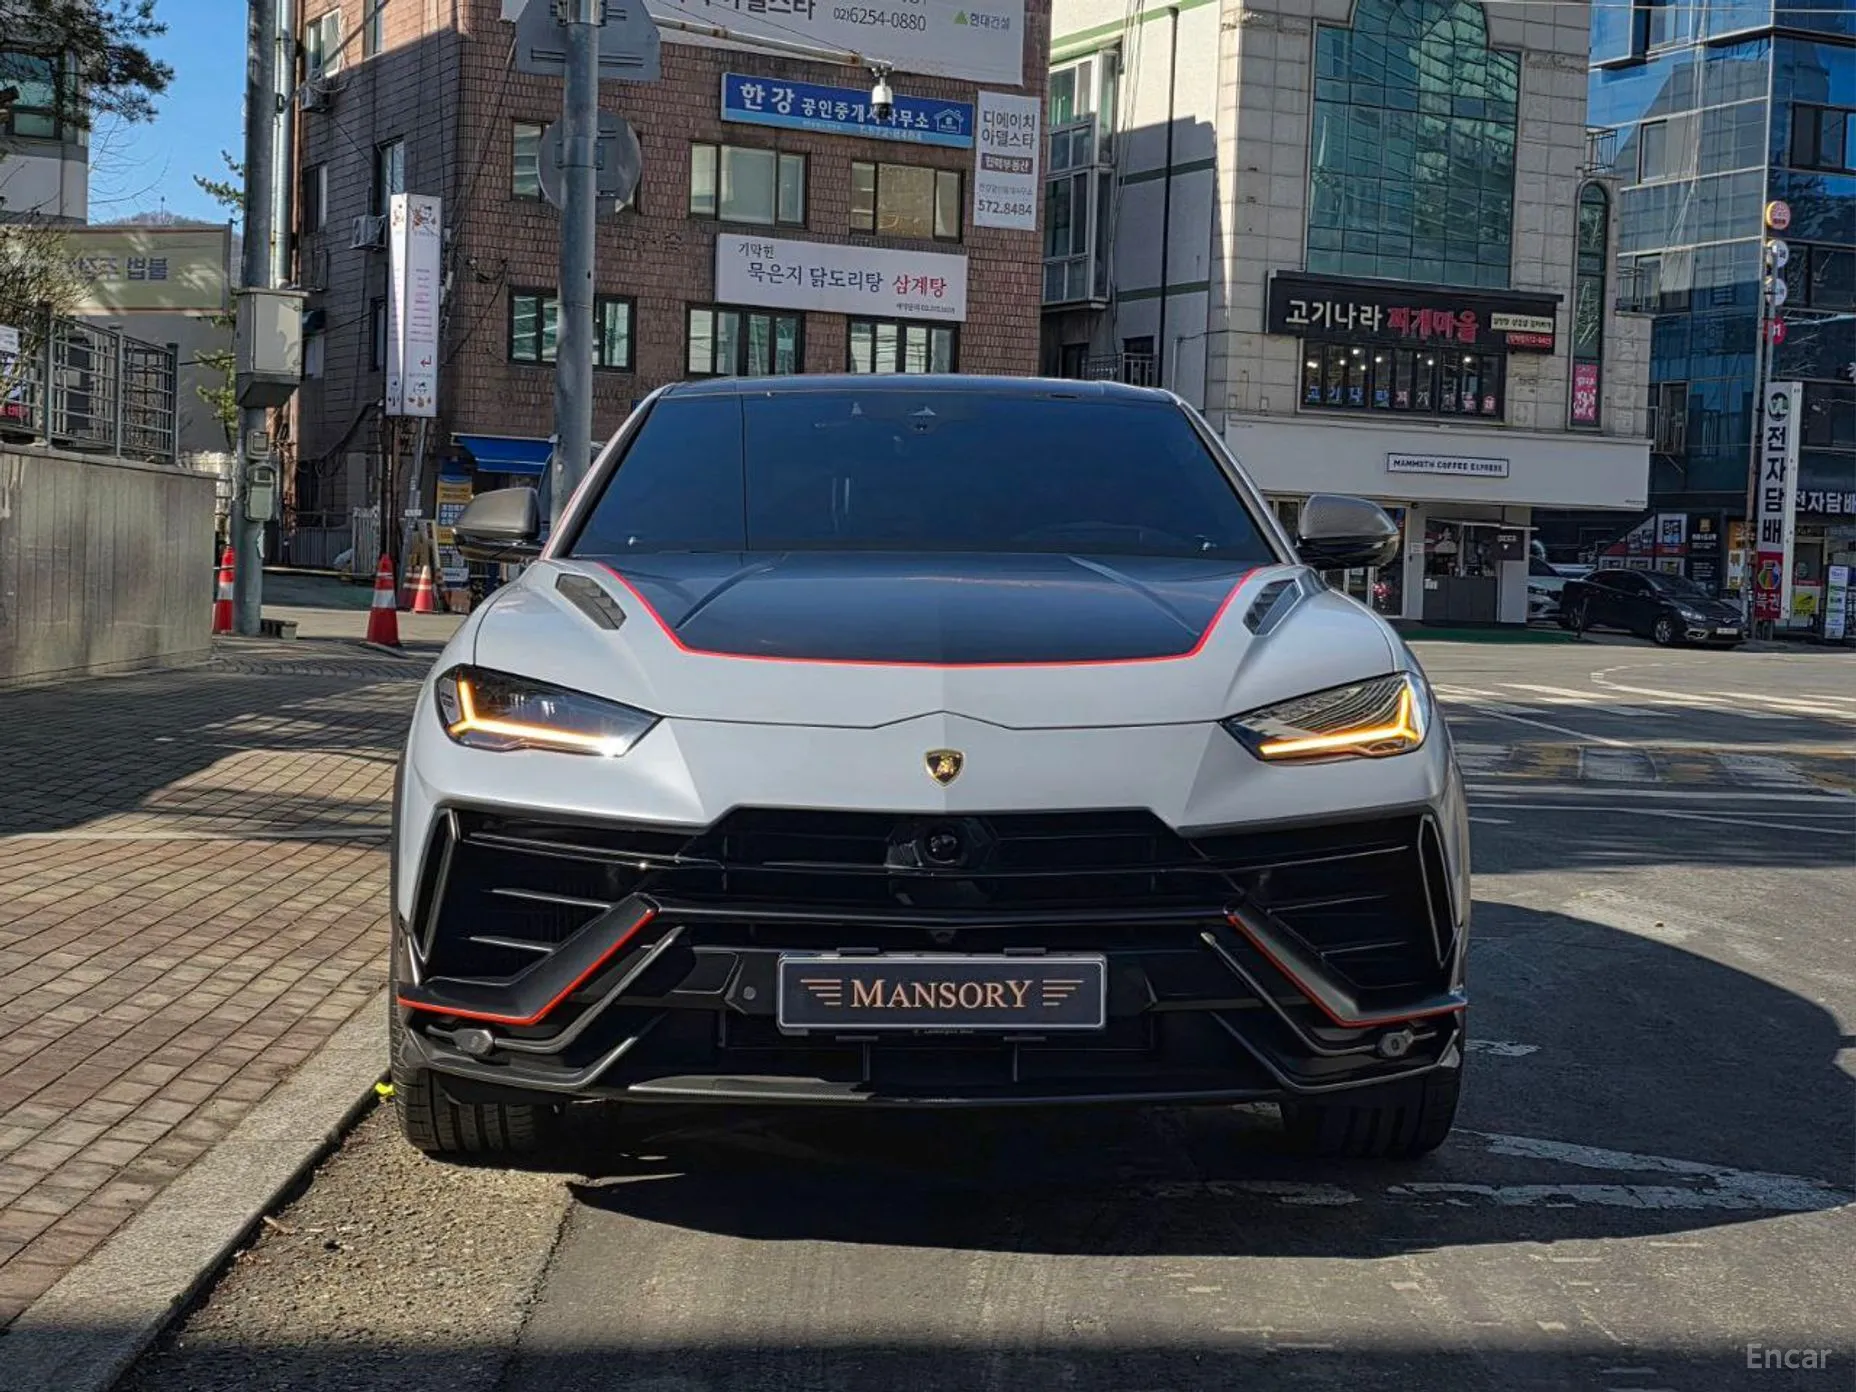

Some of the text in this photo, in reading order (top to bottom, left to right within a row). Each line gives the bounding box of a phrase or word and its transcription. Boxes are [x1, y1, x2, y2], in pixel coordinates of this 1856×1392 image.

[833, 6, 927, 32] 02)6254-0880
[740, 82, 794, 115] 한강
[983, 110, 1035, 131] 디에이치
[981, 128, 1034, 150] 아델스타
[977, 199, 1032, 216] 572.8484
[738, 242, 774, 259] 기막힌
[748, 262, 947, 298] 묵은지 닭도리탕 삼계탕
[1286, 300, 1480, 344] 고기나라 찌개마을
[1437, 460, 1468, 471] COFFEE
[1762, 426, 1787, 544] 전자담배
[851, 979, 1033, 1008] MANSORY
